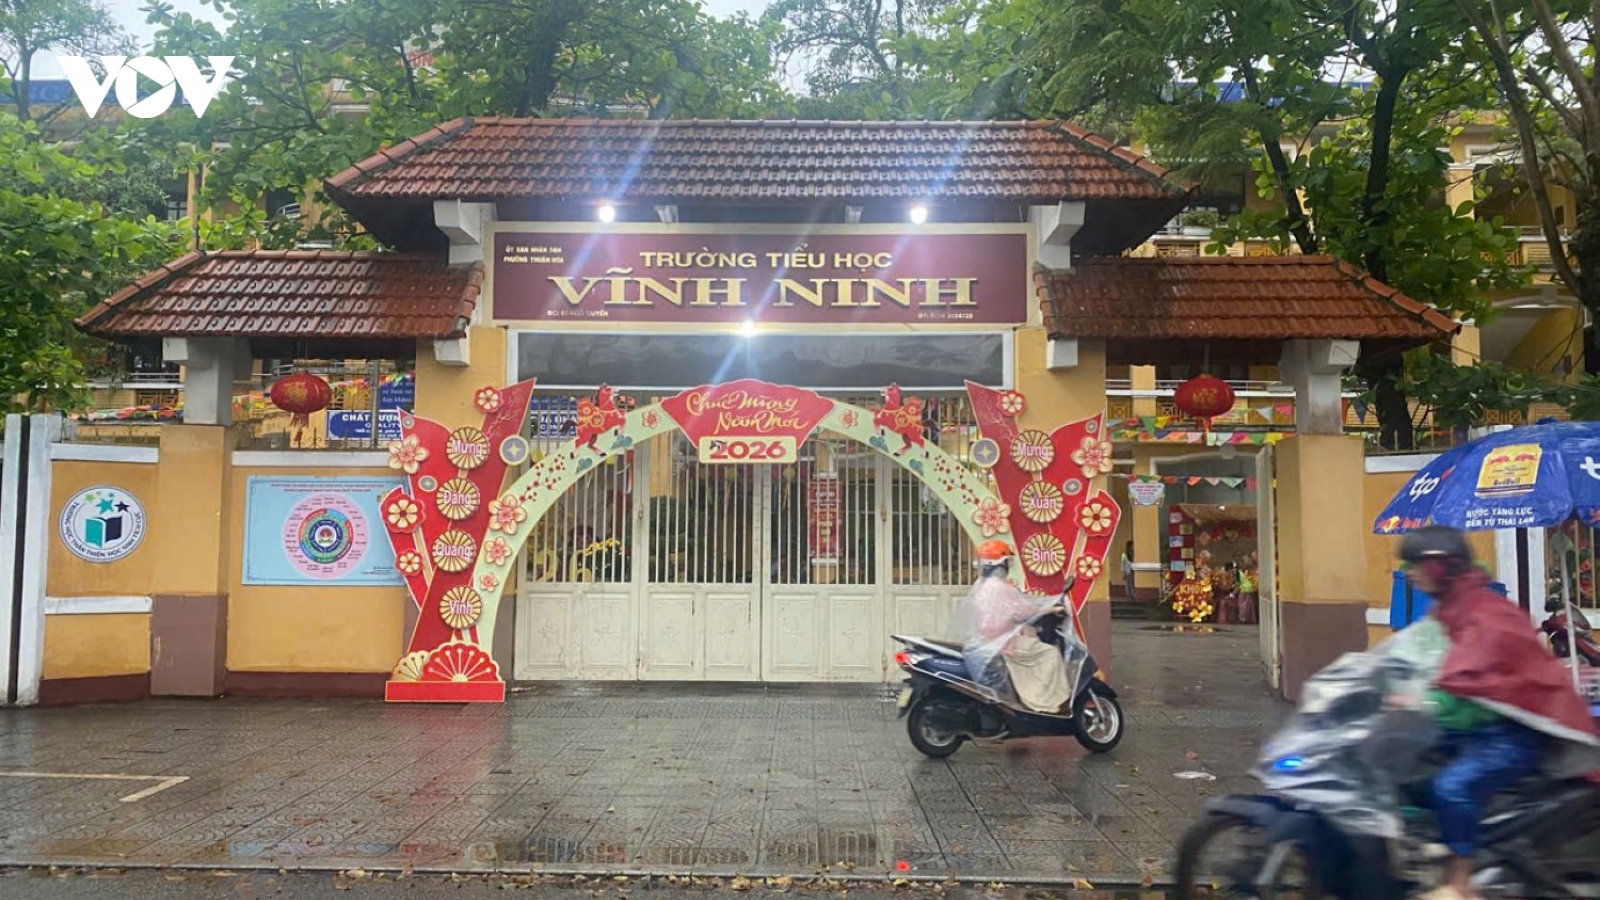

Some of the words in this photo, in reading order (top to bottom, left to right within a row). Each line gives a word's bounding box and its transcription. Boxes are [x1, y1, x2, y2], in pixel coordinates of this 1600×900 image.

[640, 247, 757, 268] TRƯỜNG
[766, 243, 826, 268] TIỂU
[834, 252, 893, 271] HỌC
[548, 266, 747, 306] VĨNH
[773, 278, 978, 307] NINH
[686, 391, 731, 416] Chúc
[726, 391, 799, 413] Mừng
[714, 411, 760, 435] Năm
[754, 409, 809, 433] Mới
[709, 440, 787, 460] 2026
[435, 543, 470, 559] Quang
[449, 599, 473, 614] Vinh
